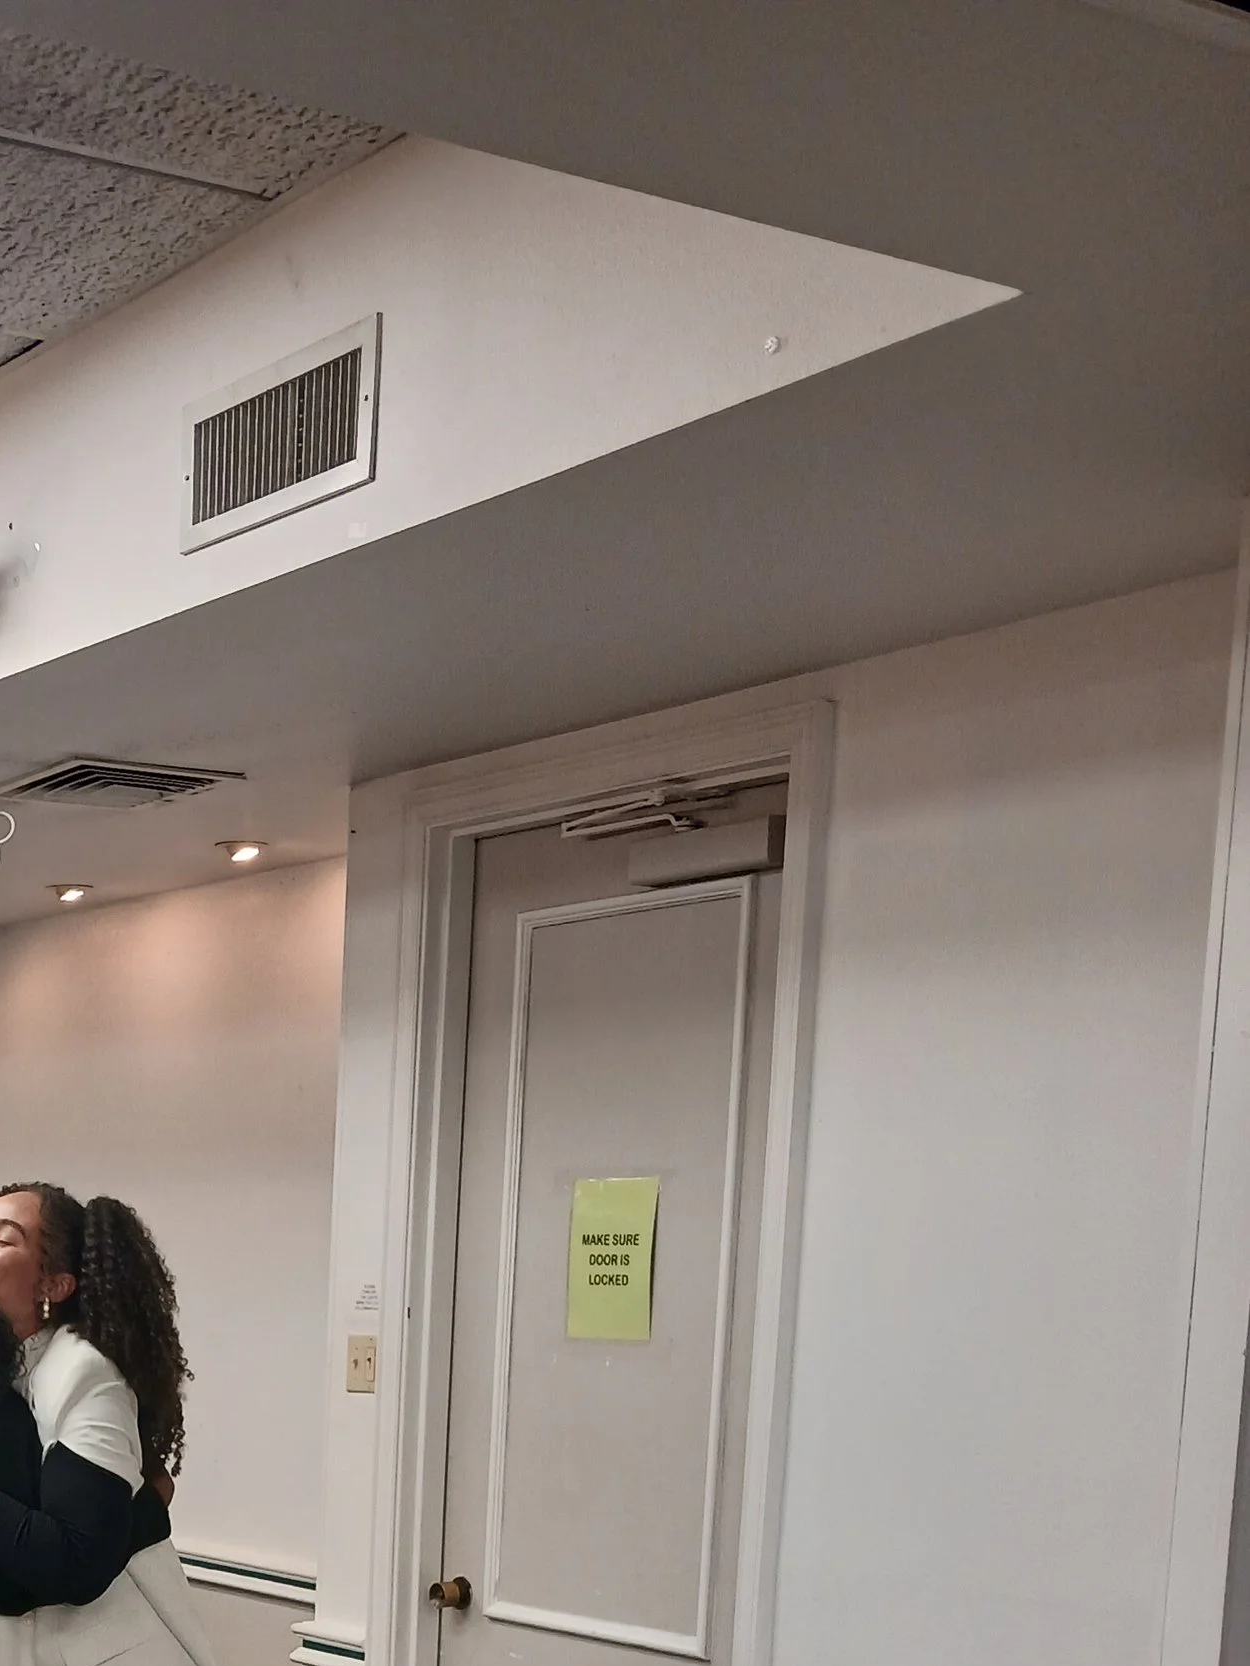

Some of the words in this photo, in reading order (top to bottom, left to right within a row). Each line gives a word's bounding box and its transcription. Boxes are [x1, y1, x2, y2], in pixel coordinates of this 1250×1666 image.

[582, 1234, 610, 1246] MAKE
[612, 1233, 639, 1246] SURE
[589, 1254, 618, 1266] DOOR
[620, 1254, 630, 1266] IS
[589, 1274, 629, 1286] LOCKED
